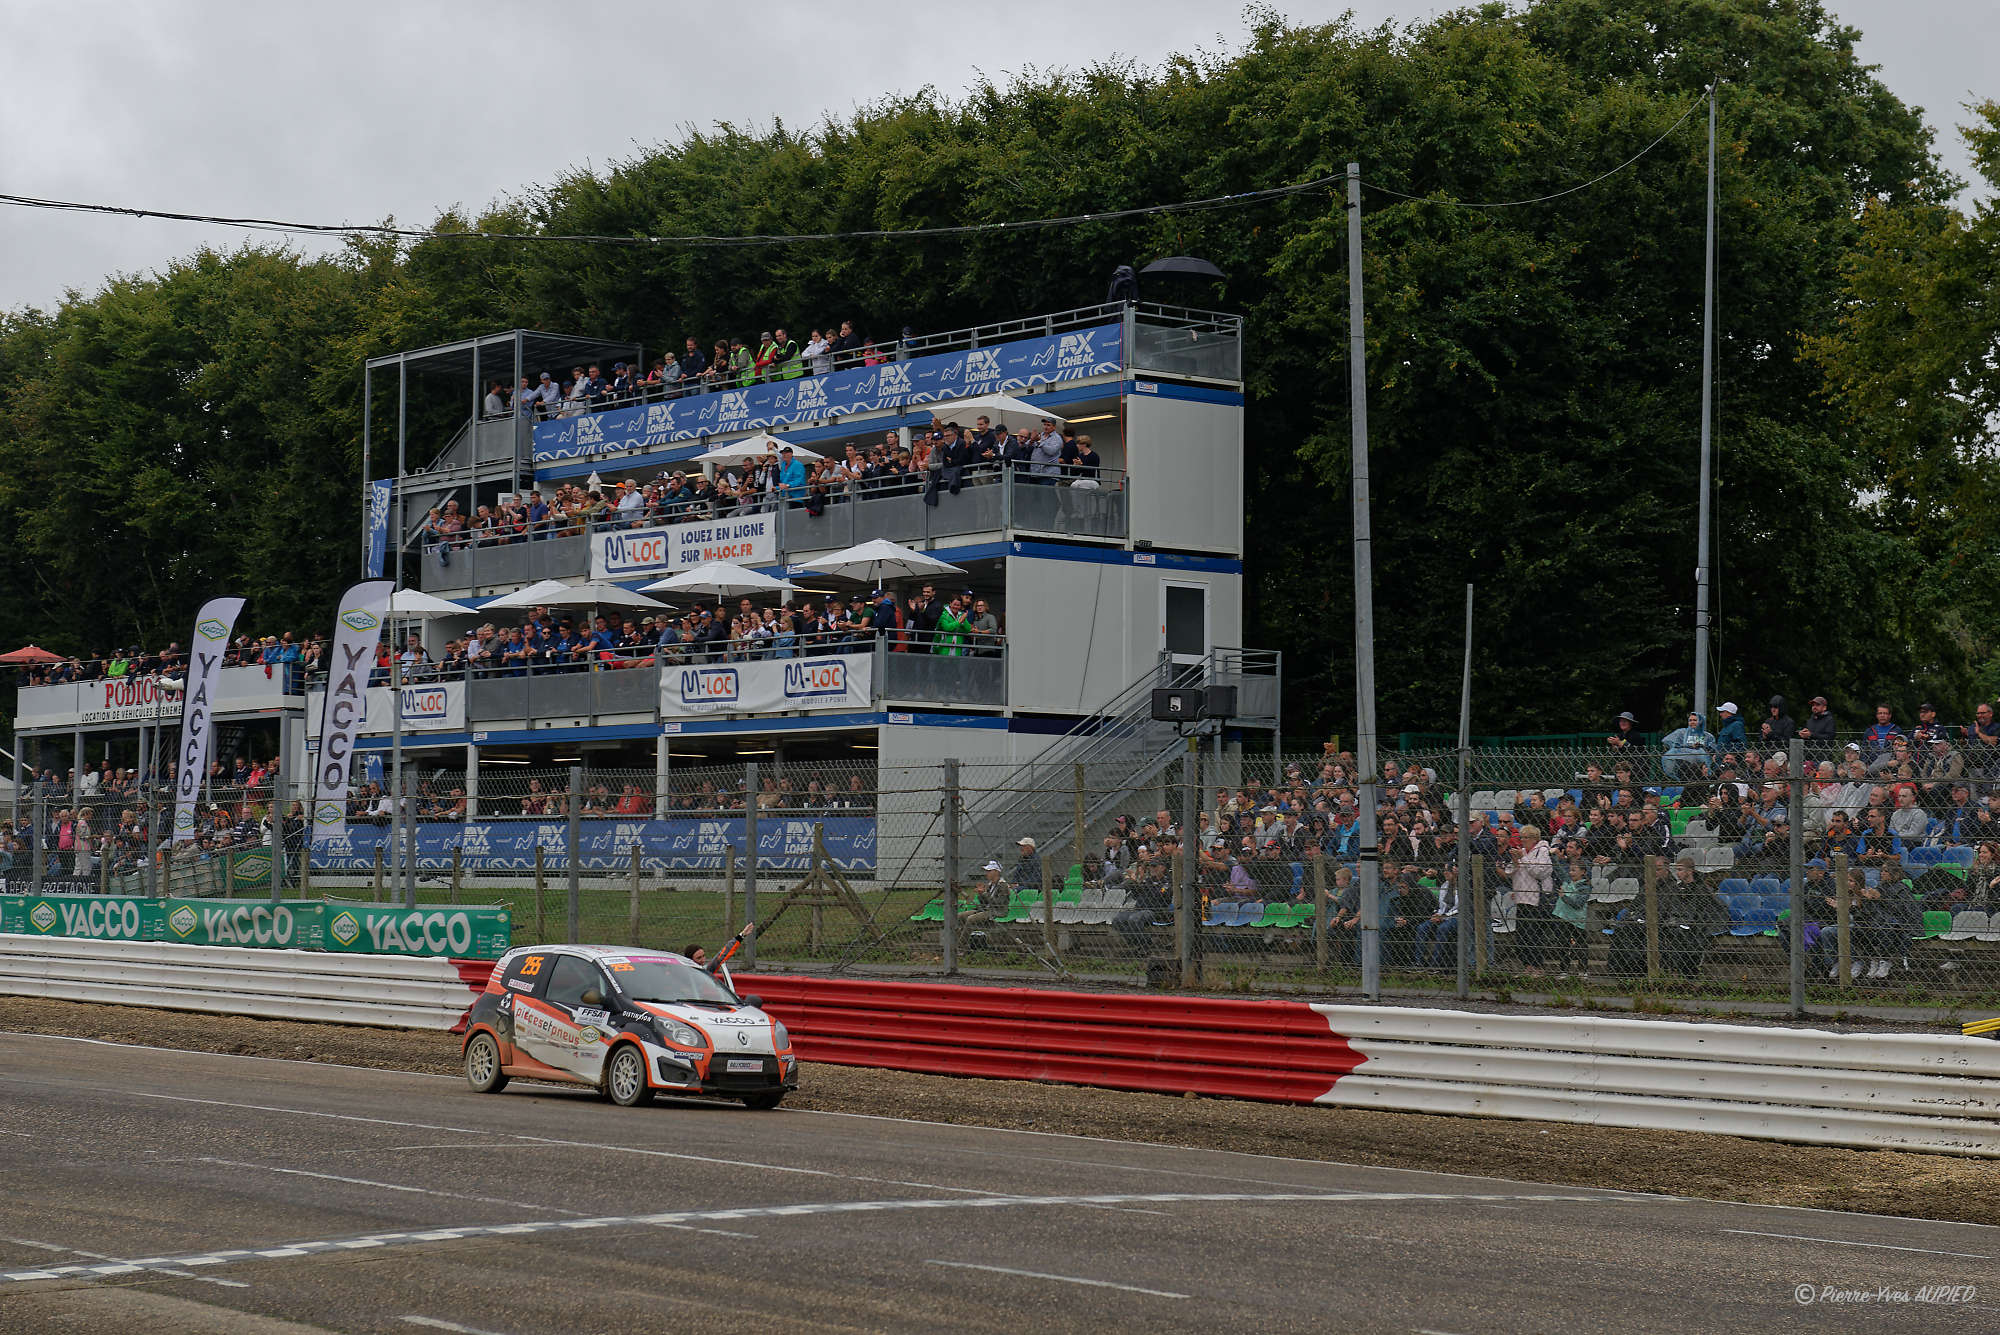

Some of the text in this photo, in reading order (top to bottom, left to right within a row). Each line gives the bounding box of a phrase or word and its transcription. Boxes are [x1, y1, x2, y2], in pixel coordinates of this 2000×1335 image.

[1058, 330, 1097, 358] RX
[965, 347, 1002, 373] RX
[1056, 351, 1095, 369] LOHEAC
[878, 362, 912, 387] RX
[964, 368, 1001, 383] LOHEAC
[797, 376, 829, 401] RX
[877, 382, 912, 397] LOHEAC
[719, 389, 750, 413] RX
[796, 395, 828, 410] LOHEAC
[647, 402, 676, 425] RX
[717, 408, 750, 422] LOHEAC
[577, 414, 605, 435] RX
[646, 421, 676, 435] LOHEAC
[576, 432, 604, 445] LOHEAC
[680, 521, 765, 545] LOUEZ EN LIGNE
[680, 542, 753, 563] SUR M-LOC.FR
[81, 707, 110, 723] LOCATION
[112, 710, 120, 720] DE
[182, 652, 218, 797] YACCO
[323, 642, 368, 791] YACCO
[463, 825, 493, 846] RX
[536, 824, 567, 845] RX
[614, 823, 647, 844] RX
[698, 822, 731, 844] RX
[613, 844, 646, 855] LOHEC
[697, 843, 729, 855] LOHEA
[59, 900, 140, 938] YACCO
[203, 905, 294, 944] YACCO
[366, 911, 472, 955] YACCO
[519, 956, 545, 976] 255
[581, 1008, 604, 1019] FFSA
[708, 1016, 756, 1025] YACCO
